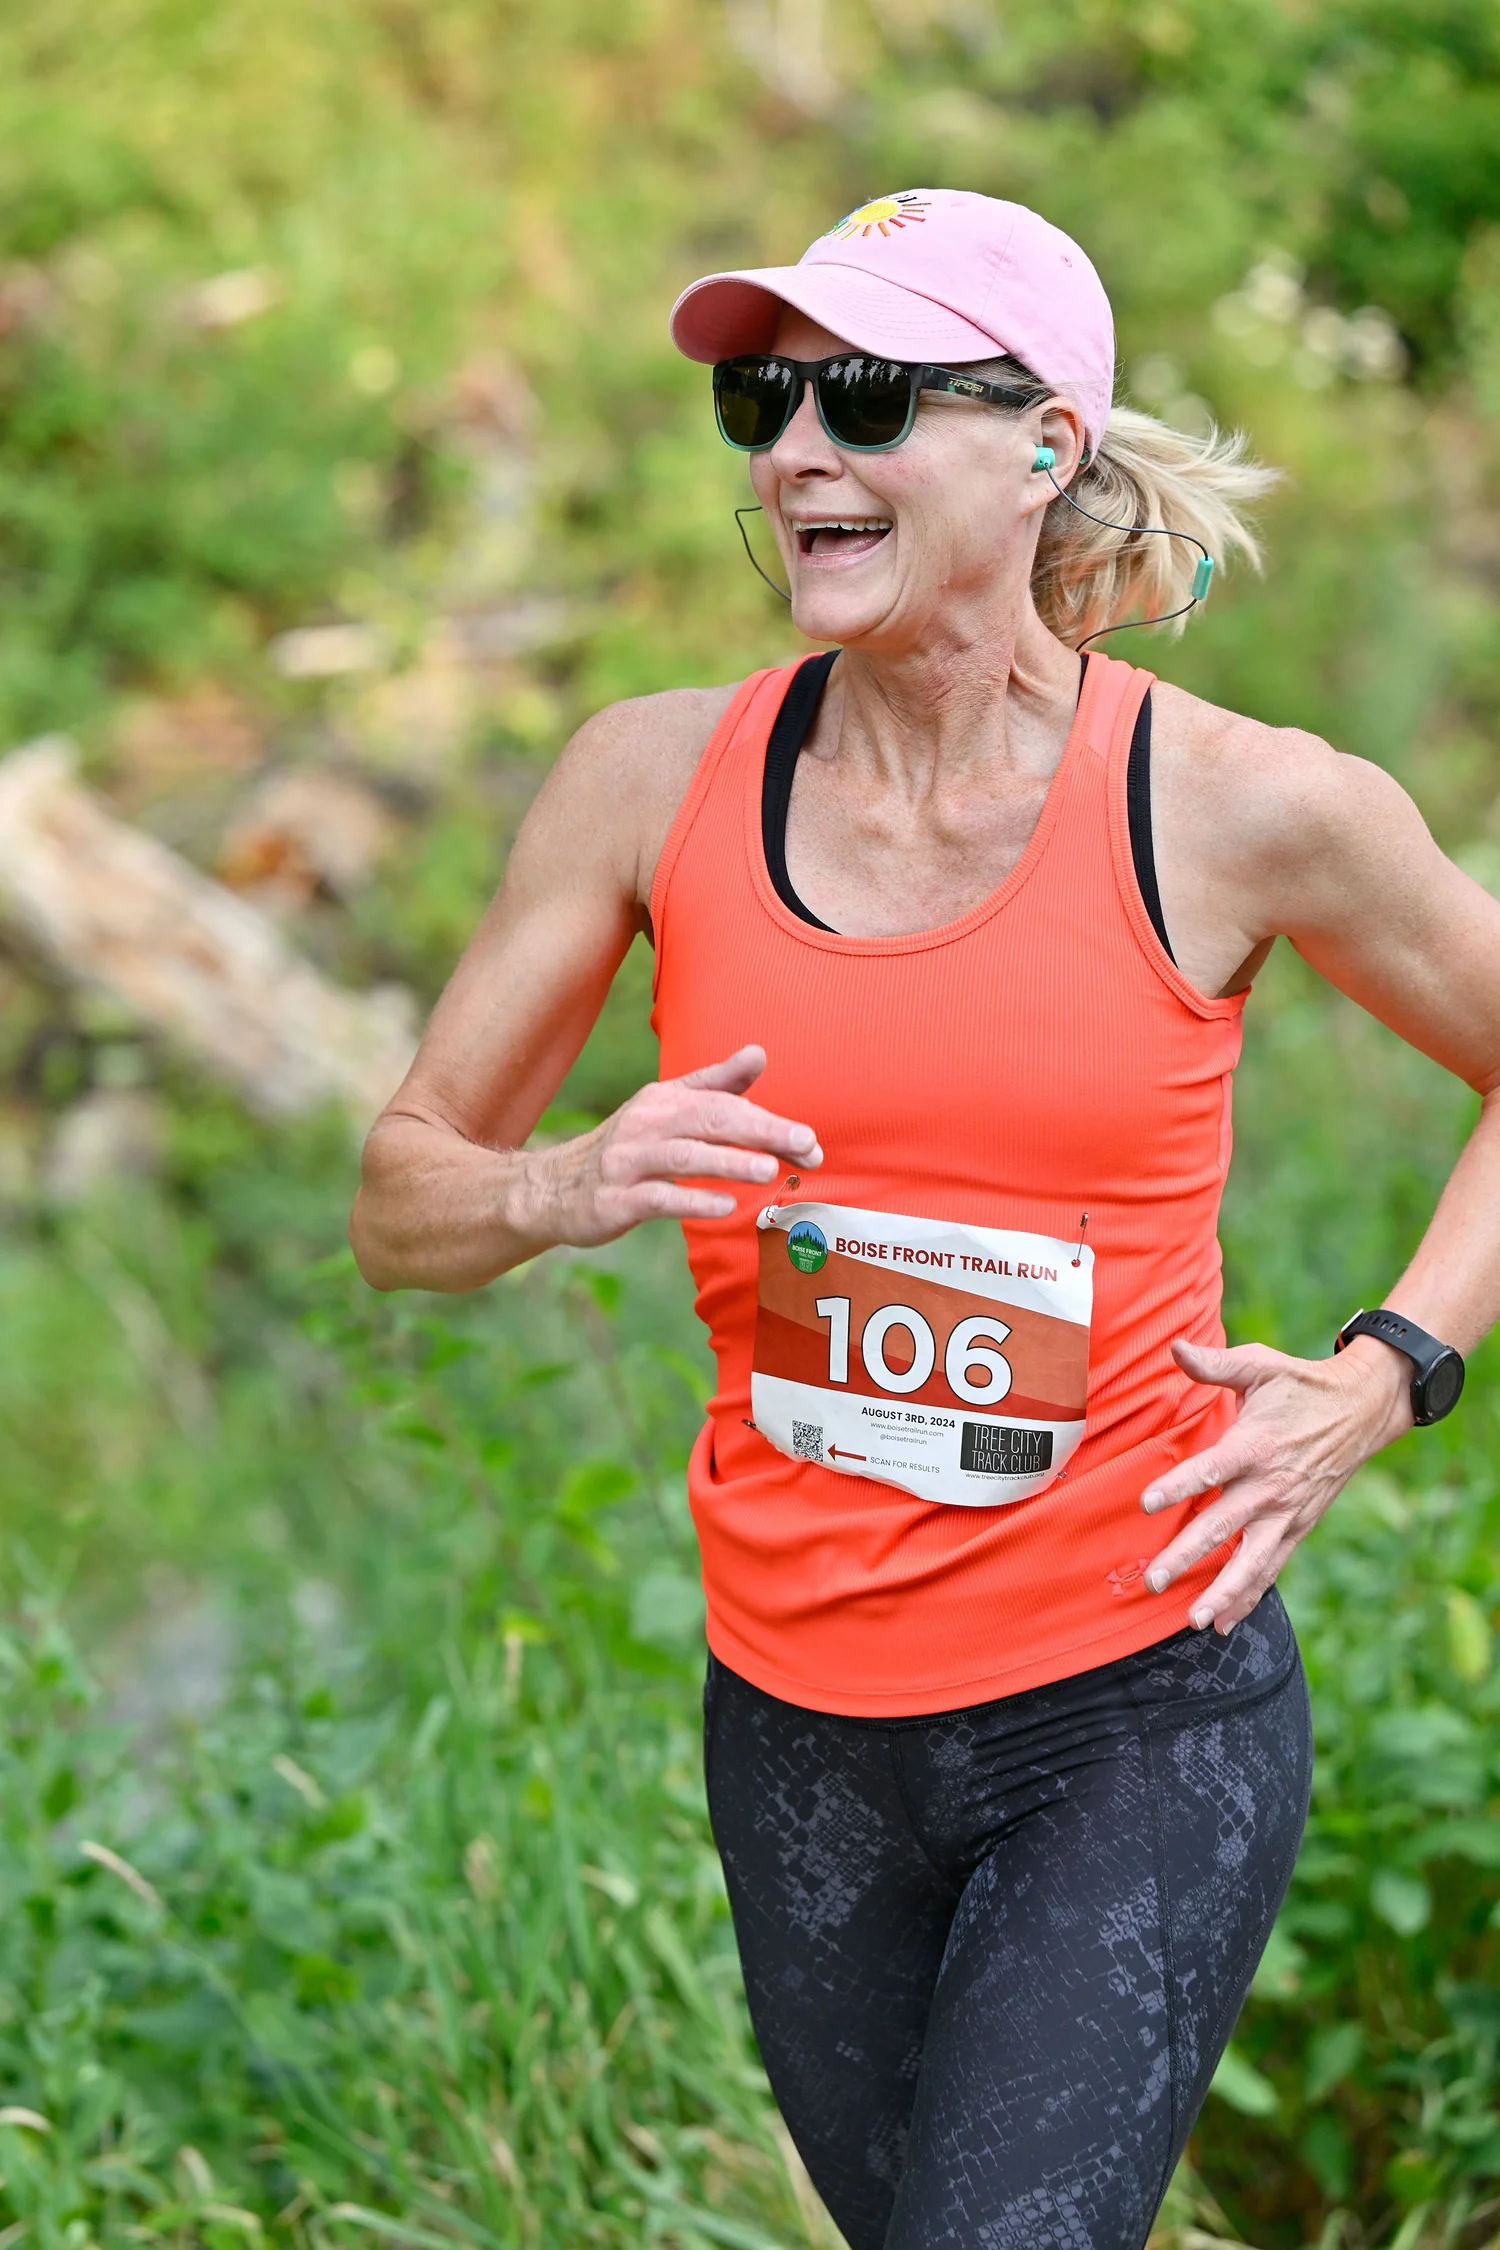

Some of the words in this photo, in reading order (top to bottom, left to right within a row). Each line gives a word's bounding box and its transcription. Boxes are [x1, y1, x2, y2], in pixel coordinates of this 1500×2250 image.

[835, 1237, 888, 1259] BOISE
[892, 1246, 955, 1268] FRONT
[959, 1255, 1013, 1276] TRAIL
[1017, 1262, 1058, 1282] RUN
[815, 1295, 1013, 1407] 106
[861, 1406, 903, 1421] AUGUST
[904, 1413, 928, 1426] 3RD,
[930, 1416, 956, 1429] 2024
[870, 1422, 944, 1438] www.boisetrailrun.com
[879, 1433, 927, 1446] @boisetrailrun
[973, 1424, 1007, 1453] TREE
[1010, 1429, 1042, 1454] CITY
[870, 1456, 891, 1467] SCAN
[892, 1460, 908, 1469] FOR
[909, 1463, 940, 1474] RESULTS
[971, 1449, 1008, 1472] TRACK
[1010, 1454, 1041, 1473] CLUB
[965, 1472, 1045, 1482] www.treecitytrackclub.org
